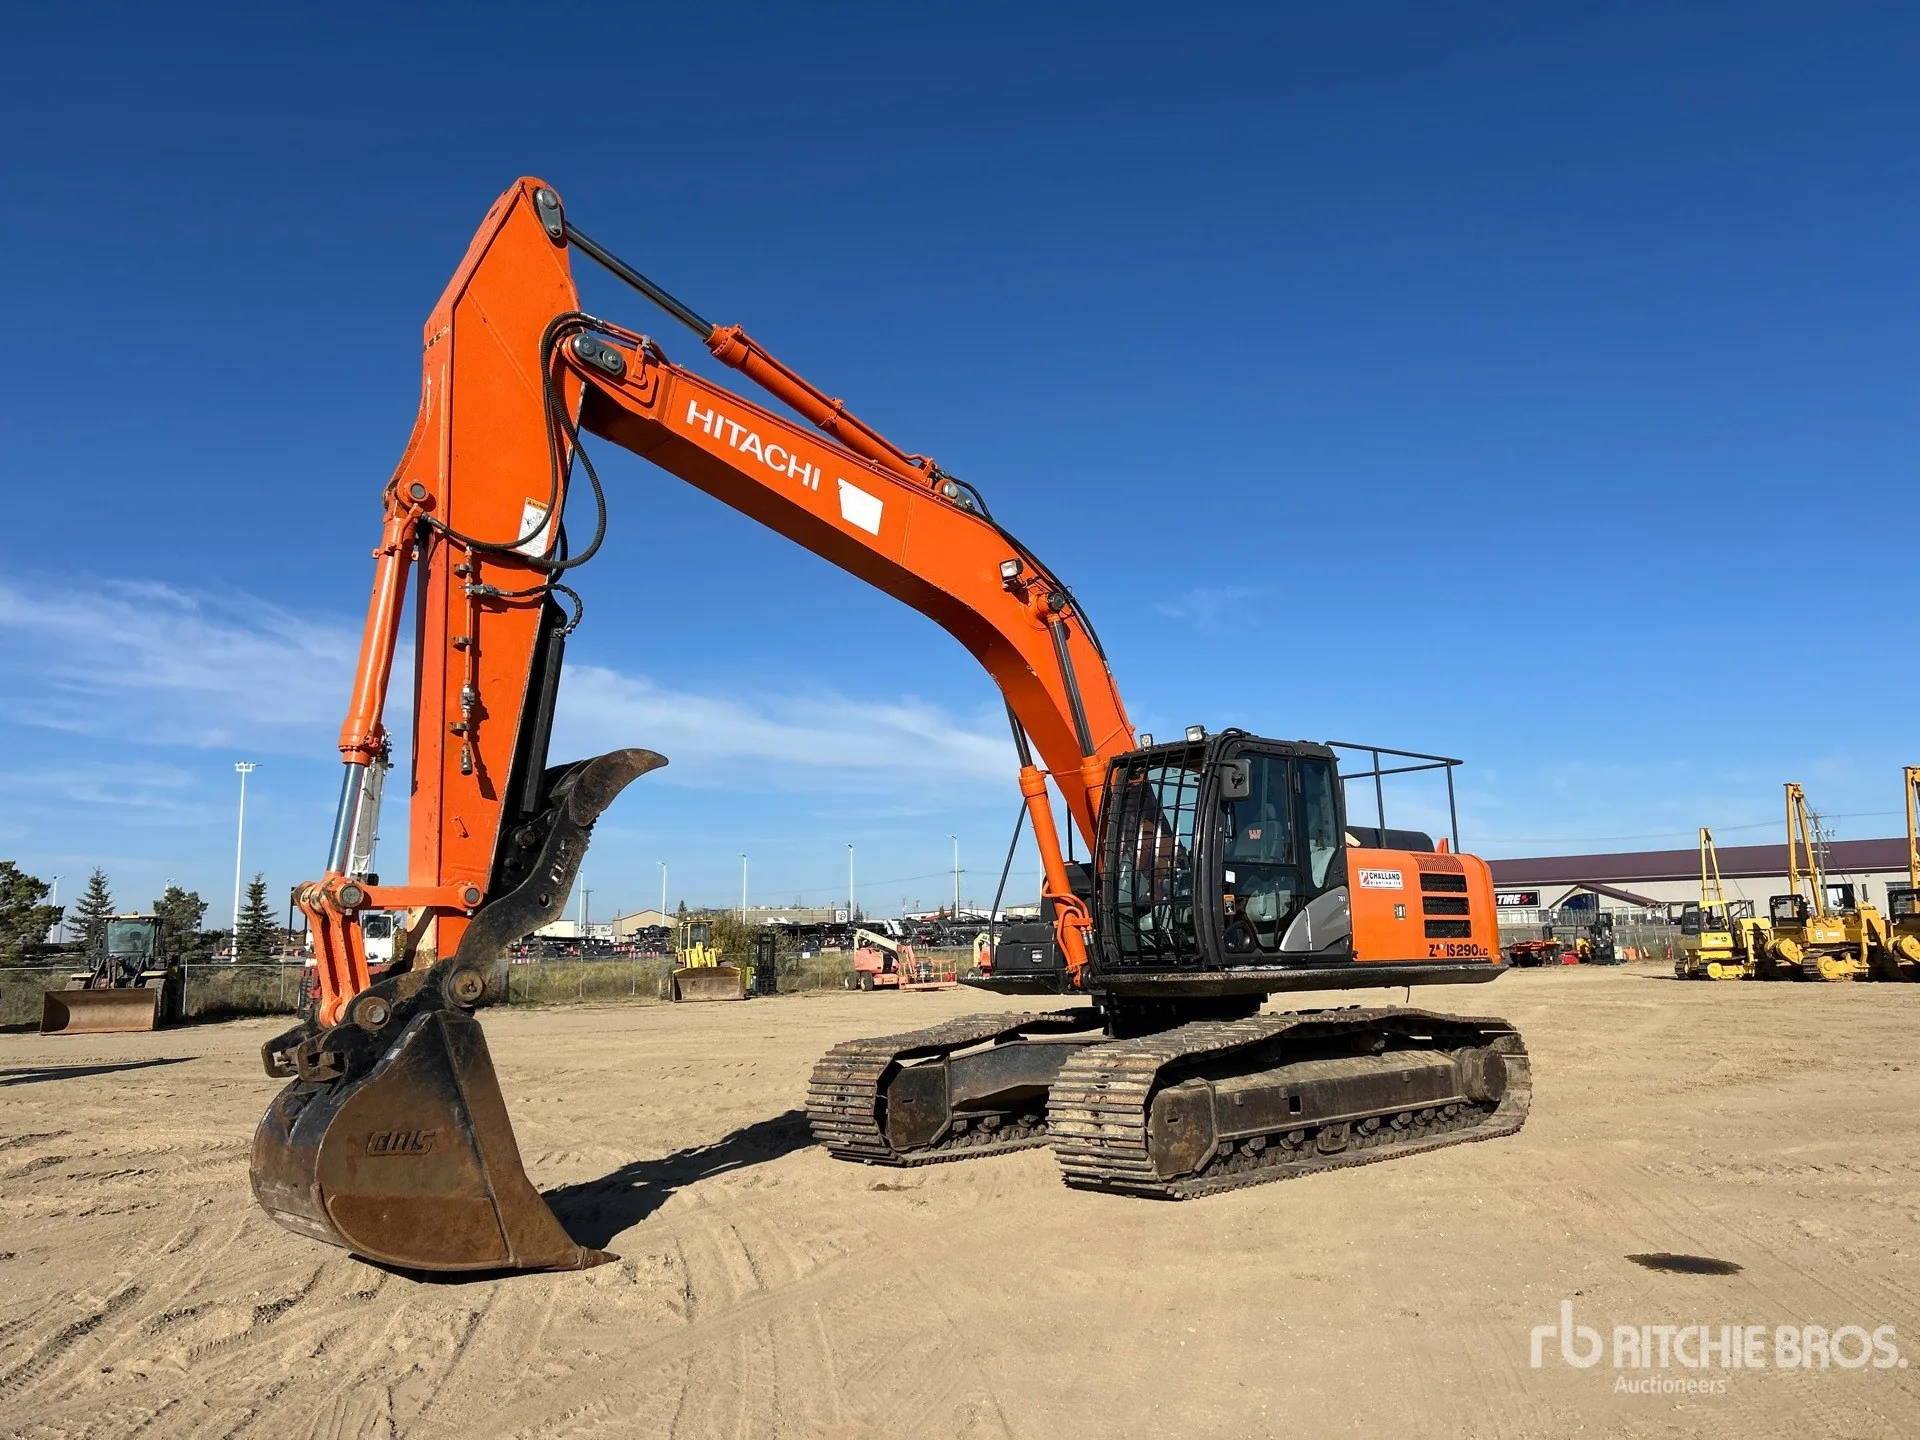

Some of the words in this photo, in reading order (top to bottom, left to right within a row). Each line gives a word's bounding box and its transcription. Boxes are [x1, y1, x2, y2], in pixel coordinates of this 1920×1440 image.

[686, 400, 821, 492] HITACHI
[1369, 872, 1401, 880] CHALLAND
[1497, 894, 1521, 905] TIRE
[1429, 944, 1488, 957] ZIS290LC
